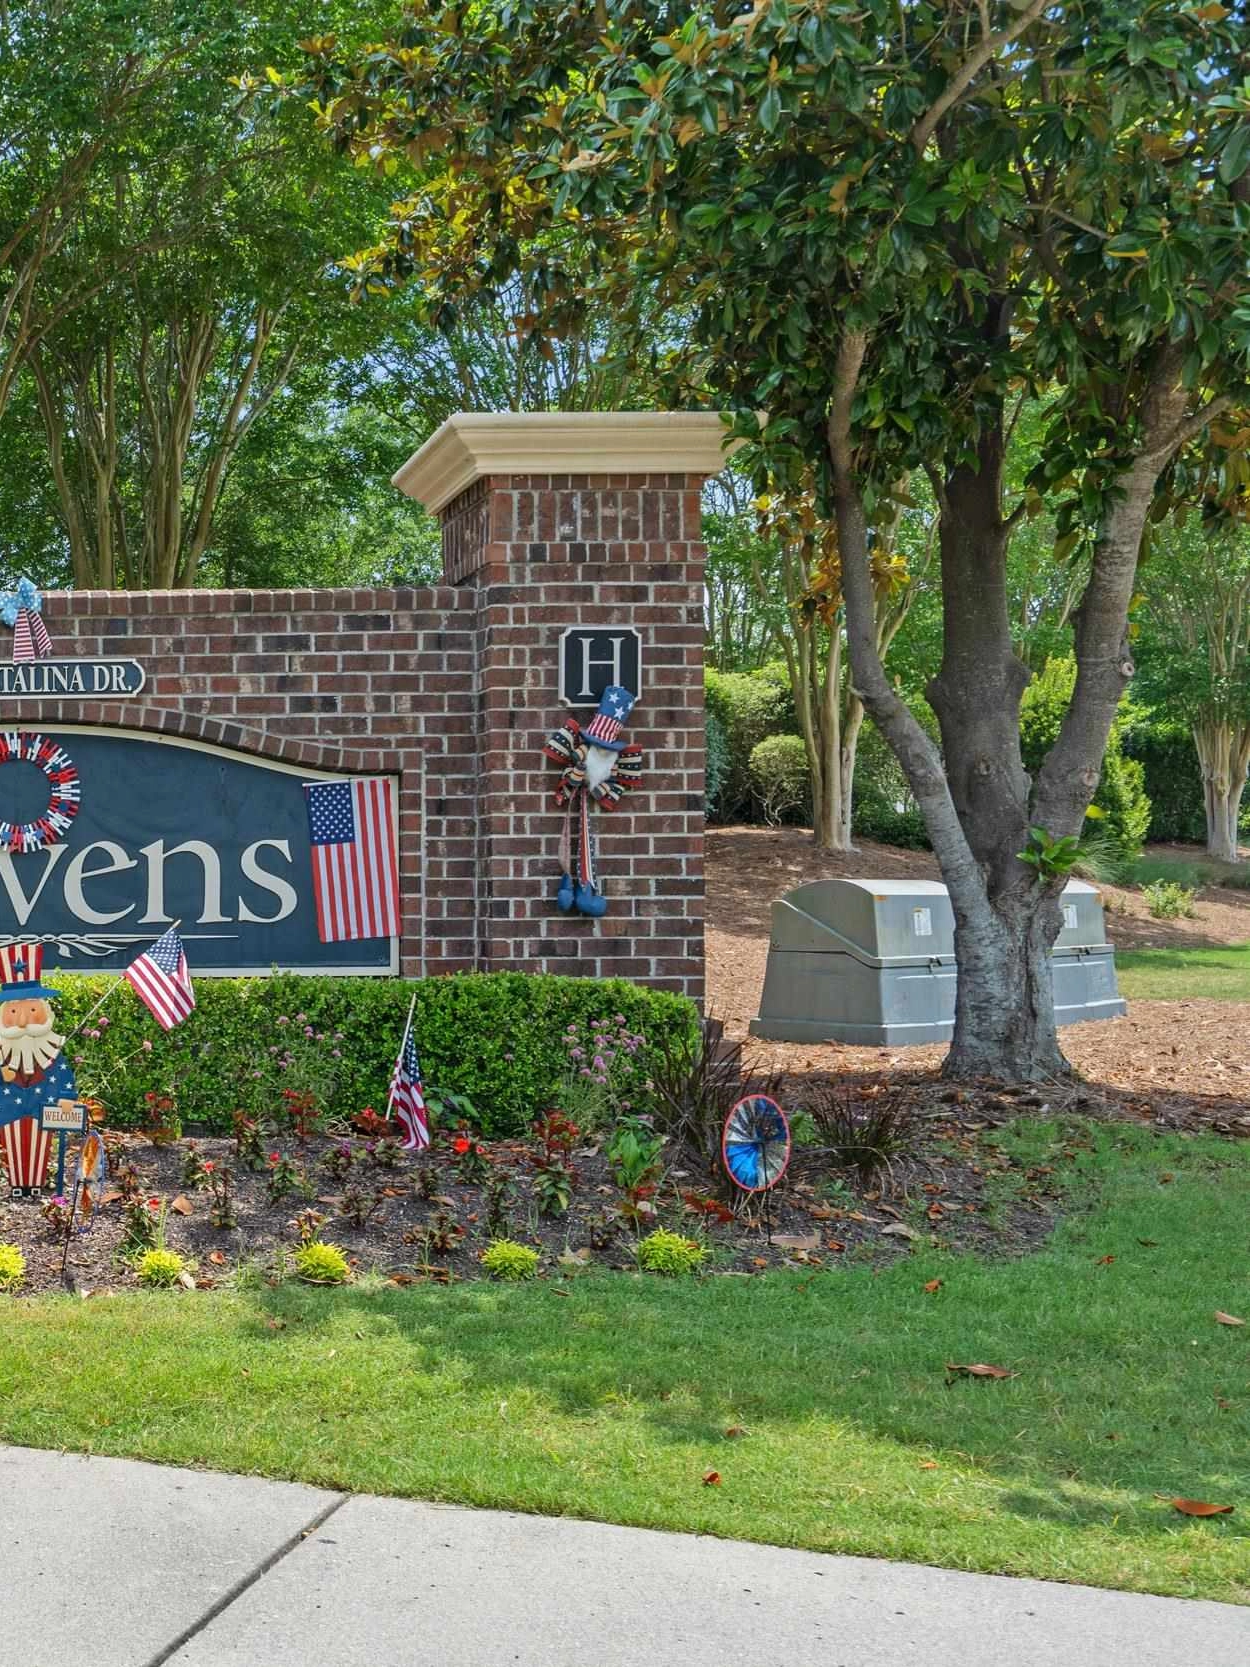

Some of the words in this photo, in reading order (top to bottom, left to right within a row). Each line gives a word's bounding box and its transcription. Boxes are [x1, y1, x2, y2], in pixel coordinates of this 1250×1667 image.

[92, 664, 132, 692] DR.
[577, 637, 626, 696] H
[45, 1111, 82, 1123] WELCOME
